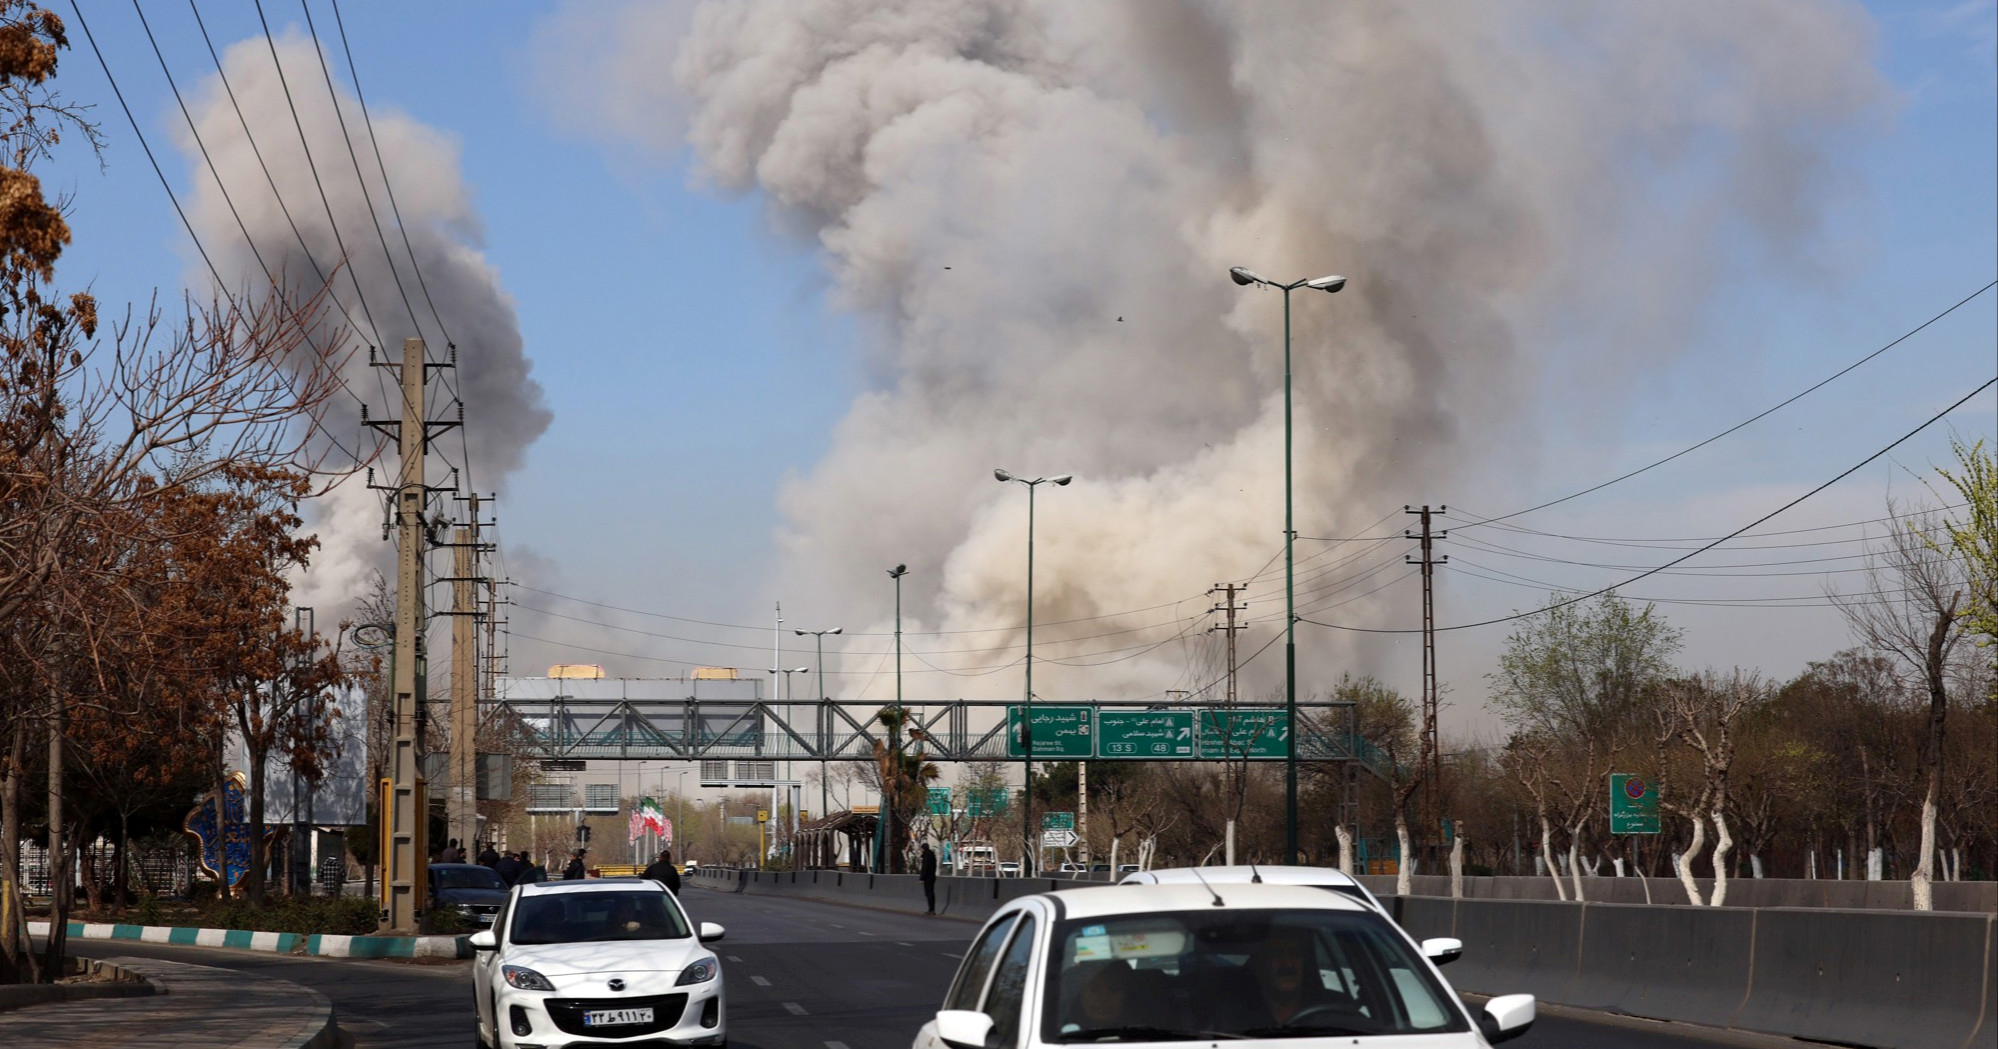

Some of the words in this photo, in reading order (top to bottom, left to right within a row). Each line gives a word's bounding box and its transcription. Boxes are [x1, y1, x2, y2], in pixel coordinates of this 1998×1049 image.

[1031, 714, 1054, 724] رجایی
[1055, 713, 1077, 722] شهید
[1112, 744, 1122, 752] 13
[1125, 744, 1132, 752] S
[1153, 744, 1167, 752] 48
